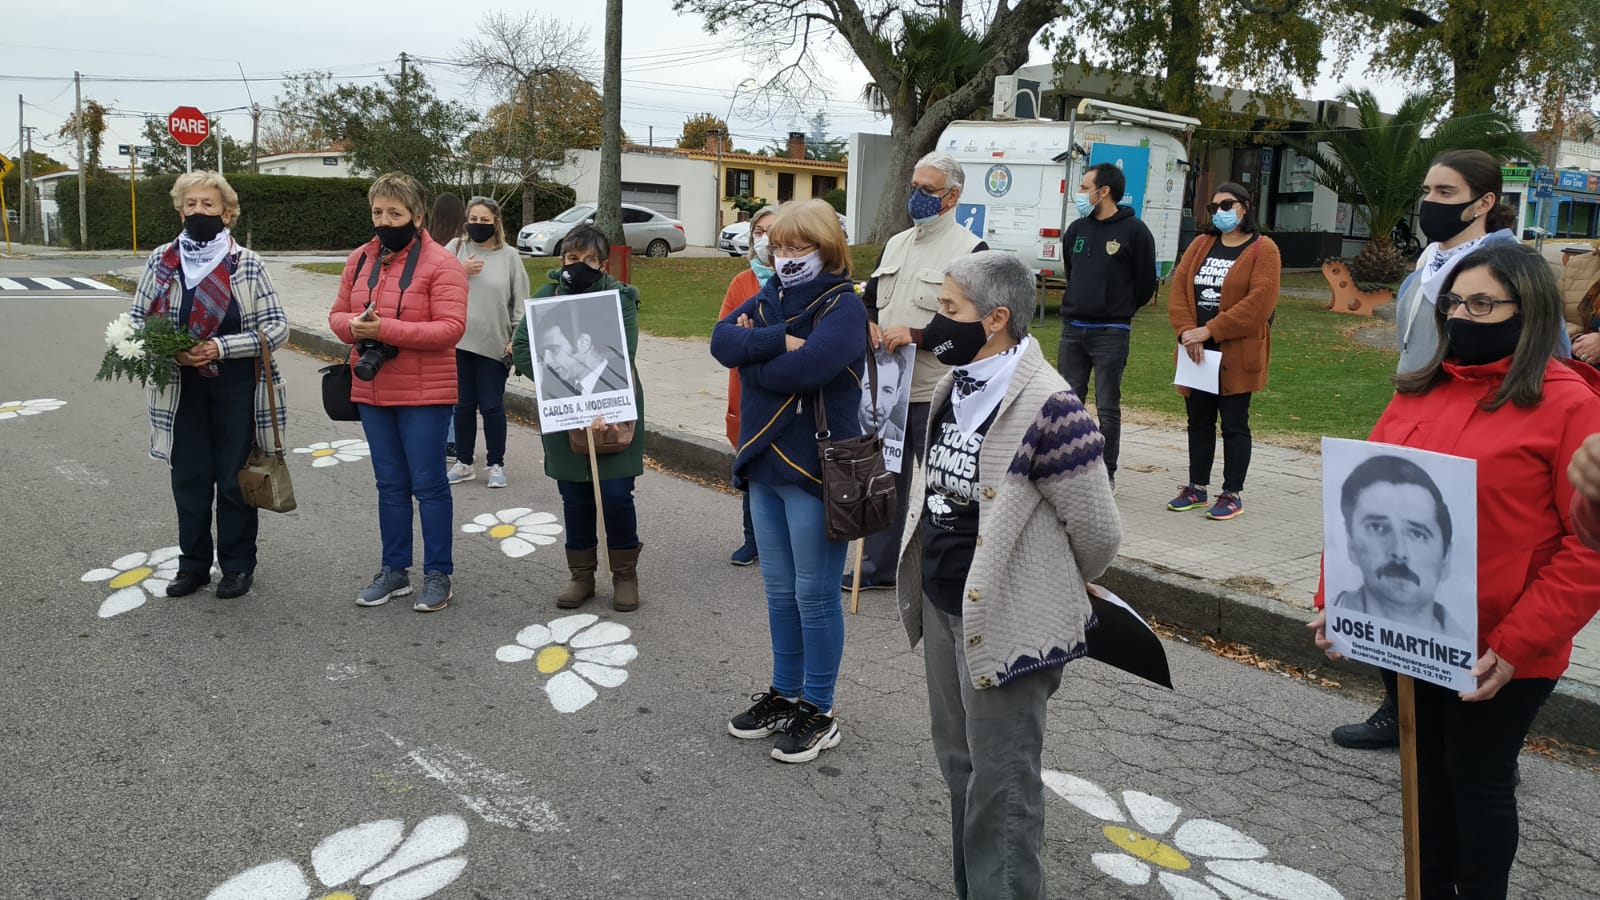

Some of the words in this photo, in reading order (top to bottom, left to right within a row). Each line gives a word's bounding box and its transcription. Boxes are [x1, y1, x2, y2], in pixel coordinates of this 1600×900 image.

[171, 117, 206, 134] PARE
[543, 403, 574, 418] CARLOS
[576, 404, 584, 413] A.
[928, 444, 977, 479] SOMOS
[1332, 616, 1375, 642] JOSÉ
[1380, 627, 1472, 670] MARTÍNEZ
[1352, 641, 1386, 656] Detenido
[1387, 651, 1440, 673] Desaparecido
[1441, 668, 1452, 676] en
[1351, 648, 1379, 661] Buenos
[1381, 656, 1401, 668] Aires
[1411, 665, 1453, 683] 23.12.1977
